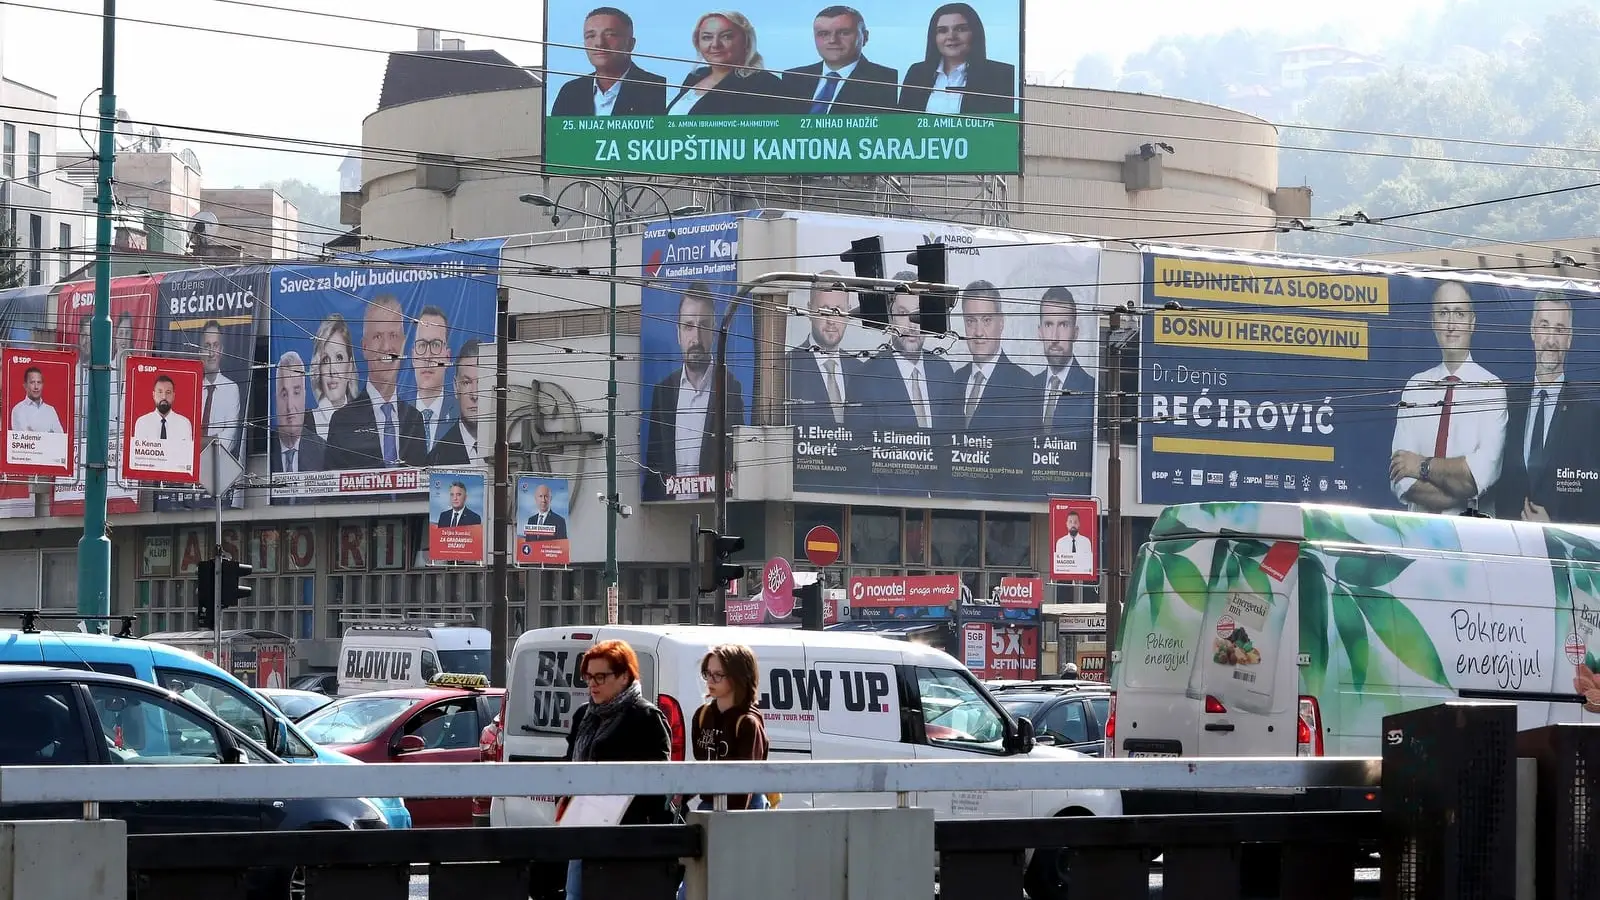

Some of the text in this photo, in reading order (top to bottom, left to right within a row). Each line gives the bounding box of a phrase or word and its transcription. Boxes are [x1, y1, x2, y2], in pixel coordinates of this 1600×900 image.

[563, 117, 655, 130] 25. NIJAZ MRAKOVIĆ
[668, 120, 677, 128] 26.
[678, 120, 698, 128] AMINA
[800, 116, 879, 129] 27. NIHAD HADŽIĆ
[917, 117, 931, 128] 28.
[933, 117, 963, 128] AMILA
[595, 134, 969, 161] ZA SKUPŠTINU KANTONA SARAJEVO
[644, 229, 667, 239] SAVEZ
[677, 227, 699, 236] BOLJU
[944, 234, 973, 244] NAROD
[665, 244, 706, 263] Amer
[280, 276, 316, 294] Savez
[317, 278, 332, 290] za
[334, 271, 367, 293] bolju
[1162, 268, 1379, 304] UJEDINJENI ZA SLOBODNU
[170, 285, 255, 315] BEĆIROVIĆ
[1162, 316, 1361, 349] BOSNU I HERCEGOVINU
[144, 365, 158, 373] SDP
[1152, 388, 1335, 436] BEĆIROVIĆ
[11, 433, 42, 442] 12. Ademir
[797, 425, 853, 441] 1. Elvedin
[872, 430, 932, 447] 1. Elmedin
[951, 434, 961, 446] 1.
[11, 440, 36, 451] SPAHIĆ
[135, 440, 162, 448] 6. Kenan
[797, 441, 838, 457] Okerić
[1032, 436, 1041, 449] 1.
[134, 448, 165, 458] MAGODA
[1032, 452, 1060, 466] Delić
[342, 474, 393, 490] PAMETNA
[397, 471, 418, 487] BiH
[1156, 471, 1169, 480] SDP
[1557, 467, 1599, 480] Edin Forto
[666, 476, 716, 494] PAMETN
[867, 580, 906, 597] novotel
[909, 587, 931, 598] snaga
[1000, 582, 1033, 598] votel
[1228, 604, 1241, 617] mix
[1232, 593, 1269, 618] Energetski
[1087, 618, 1105, 627] ULAZ
[1450, 608, 1527, 645] Pokreni
[967, 632, 983, 641] 5GB
[1145, 632, 1185, 651] Pokreni
[346, 649, 413, 681] BLOW UP.
[990, 658, 1037, 671] JEFTINIJE
[1082, 657, 1105, 670] INN
[1144, 651, 1190, 672] energiju!
[1081, 672, 1104, 681] SPORT
[1456, 649, 1541, 690] energiju!
[839, 670, 889, 713] UP.
[534, 690, 571, 728] UP.
[763, 713, 815, 722] BLOW YOUR MIND
